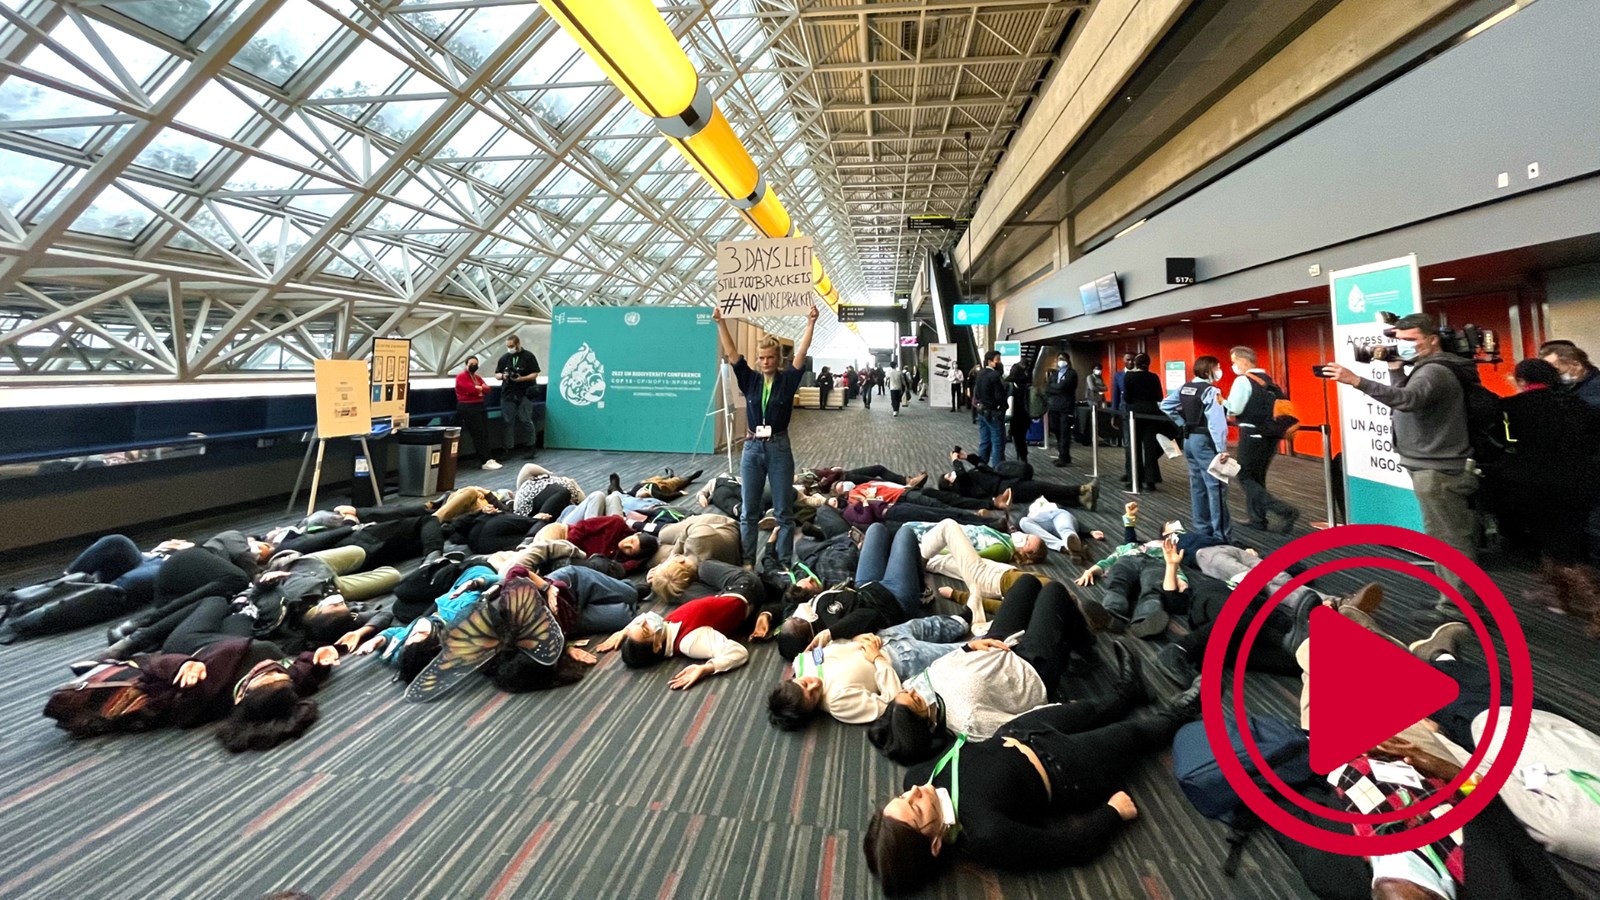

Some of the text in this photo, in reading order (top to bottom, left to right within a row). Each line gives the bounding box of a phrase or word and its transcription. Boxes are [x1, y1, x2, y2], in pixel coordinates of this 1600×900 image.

[723, 246, 813, 275] 3 DAYS LEFT
[717, 278, 737, 292] STILL
[755, 272, 812, 290] BRACKETS
[1371, 368, 1387, 380] for
[1376, 405, 1388, 416] to
[1350, 418, 1366, 431] UN
[1371, 438, 1393, 452] IGO
[1370, 455, 1403, 473] NGOs
